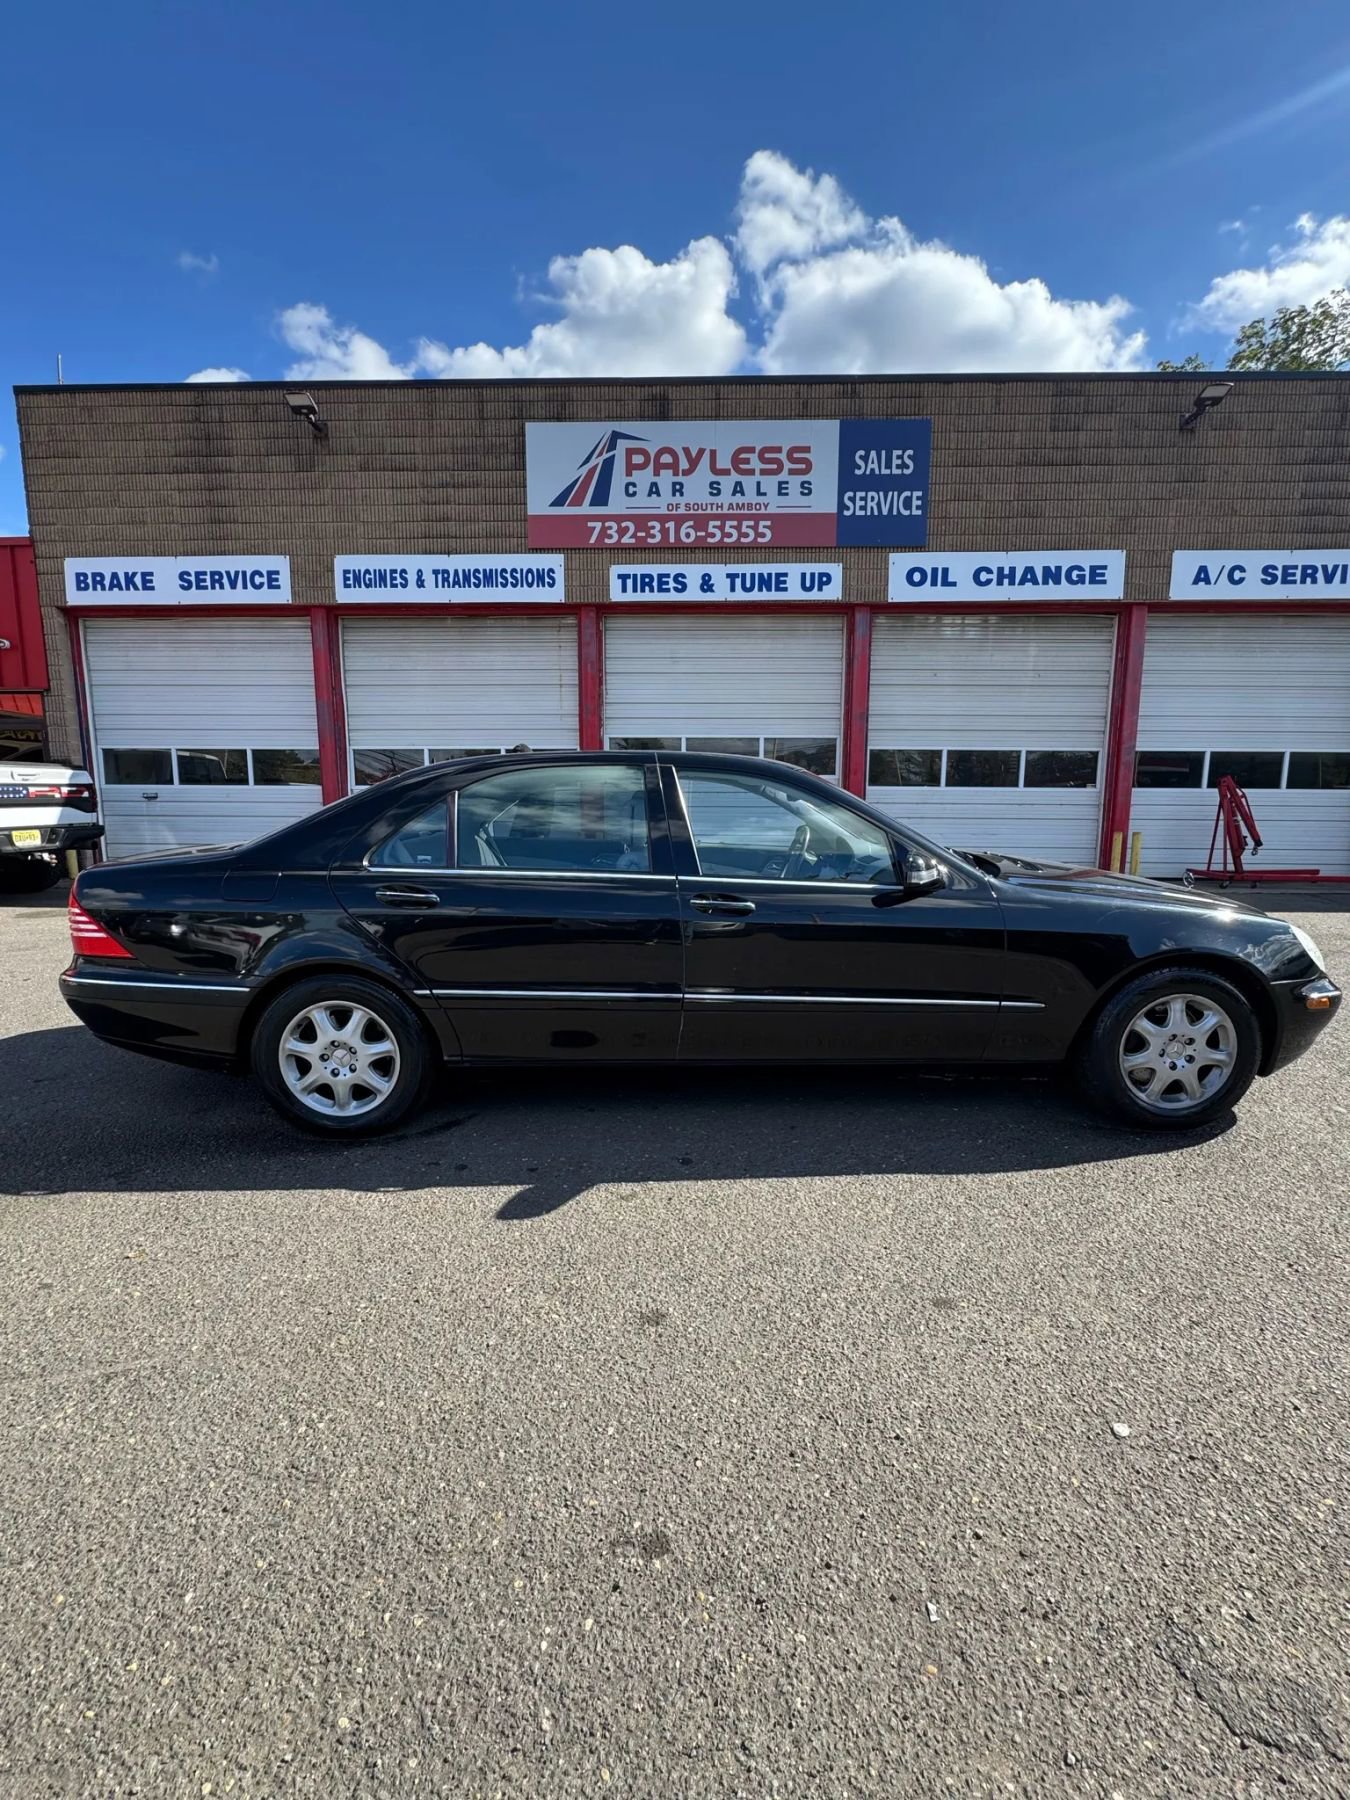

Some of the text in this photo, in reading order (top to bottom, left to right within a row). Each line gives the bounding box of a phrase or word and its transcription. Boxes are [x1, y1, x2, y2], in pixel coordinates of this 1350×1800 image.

[624, 445, 814, 477] PAYLESS
[854, 449, 914, 475] SALES
[624, 479, 814, 498] CAR SALES
[666, 501, 770, 513] OF SOUTH AMBOY
[843, 490, 923, 516] SERVICE
[587, 520, 773, 544] 732-316-5555
[75, 569, 282, 592] BRAKE SERVICE
[342, 567, 557, 590] ENGINES & TRANSMISSIONS
[617, 571, 833, 594] TIRES & TUNE UP
[905, 564, 1109, 588] OIL CHANGE
[1191, 563, 1350, 586] A/C SERVI
